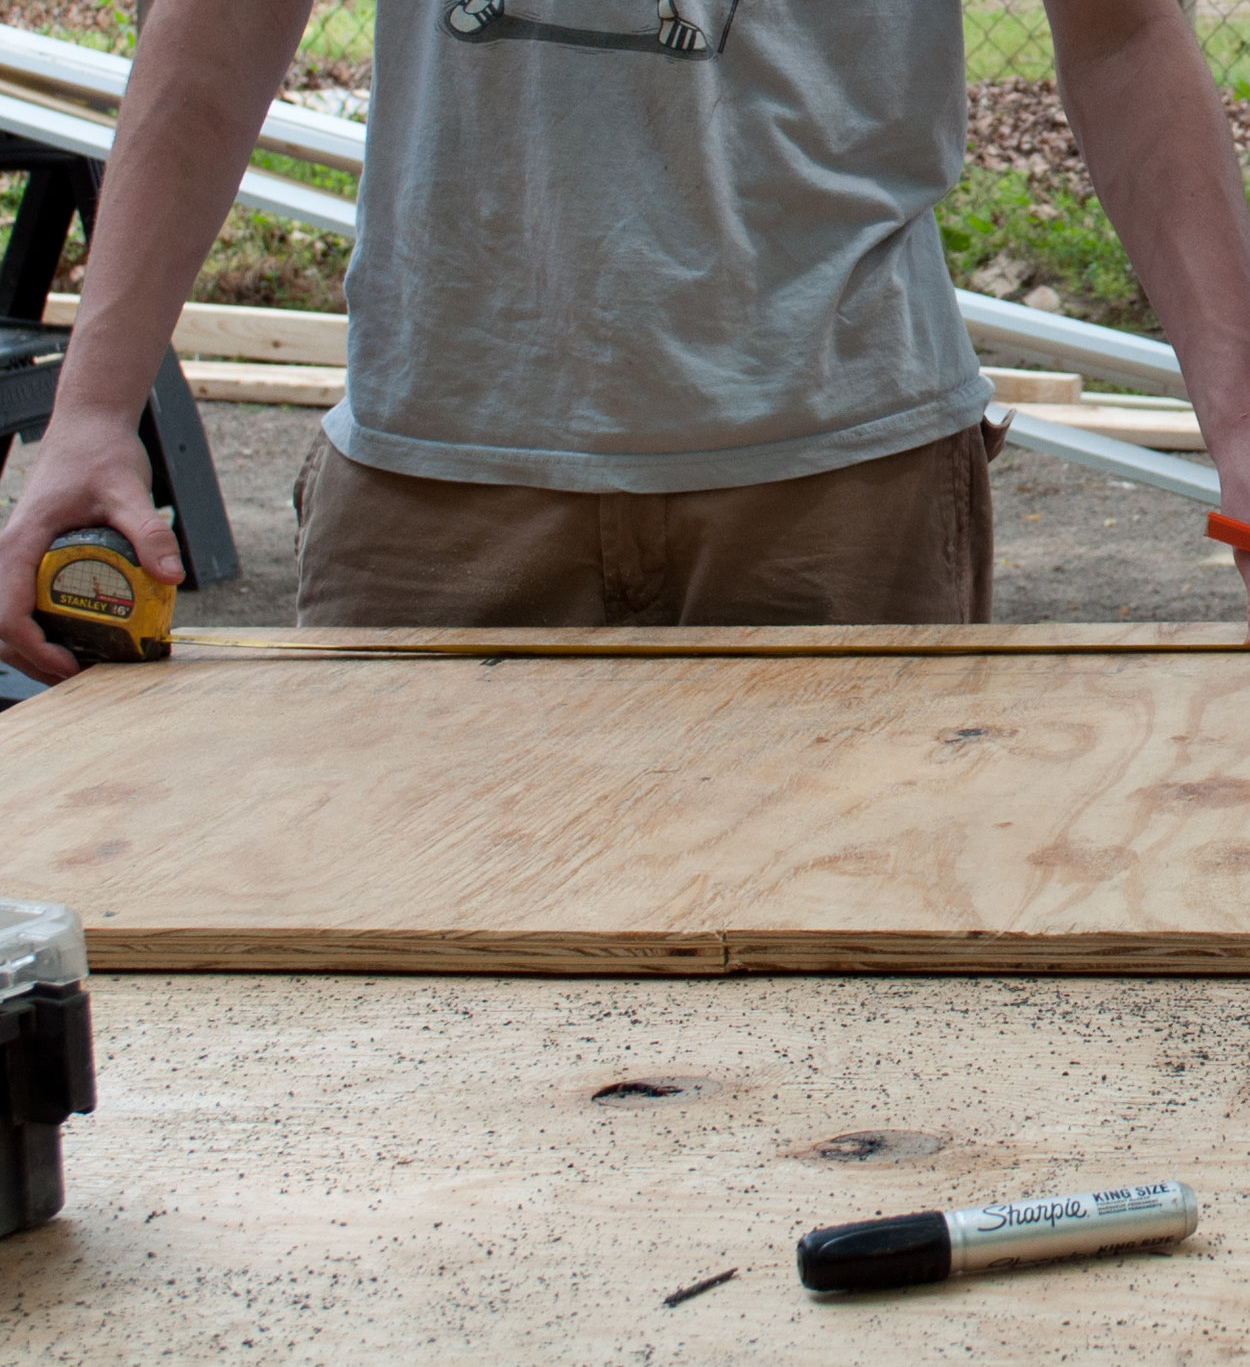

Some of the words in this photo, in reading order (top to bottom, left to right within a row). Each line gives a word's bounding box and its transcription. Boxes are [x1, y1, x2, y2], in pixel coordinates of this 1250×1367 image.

[60, 594, 108, 612] STANLEY
[1092, 1188, 1132, 1203] KING
[1135, 1183, 1171, 1197] SIZE
[976, 1198, 1087, 1232] Sharpie
